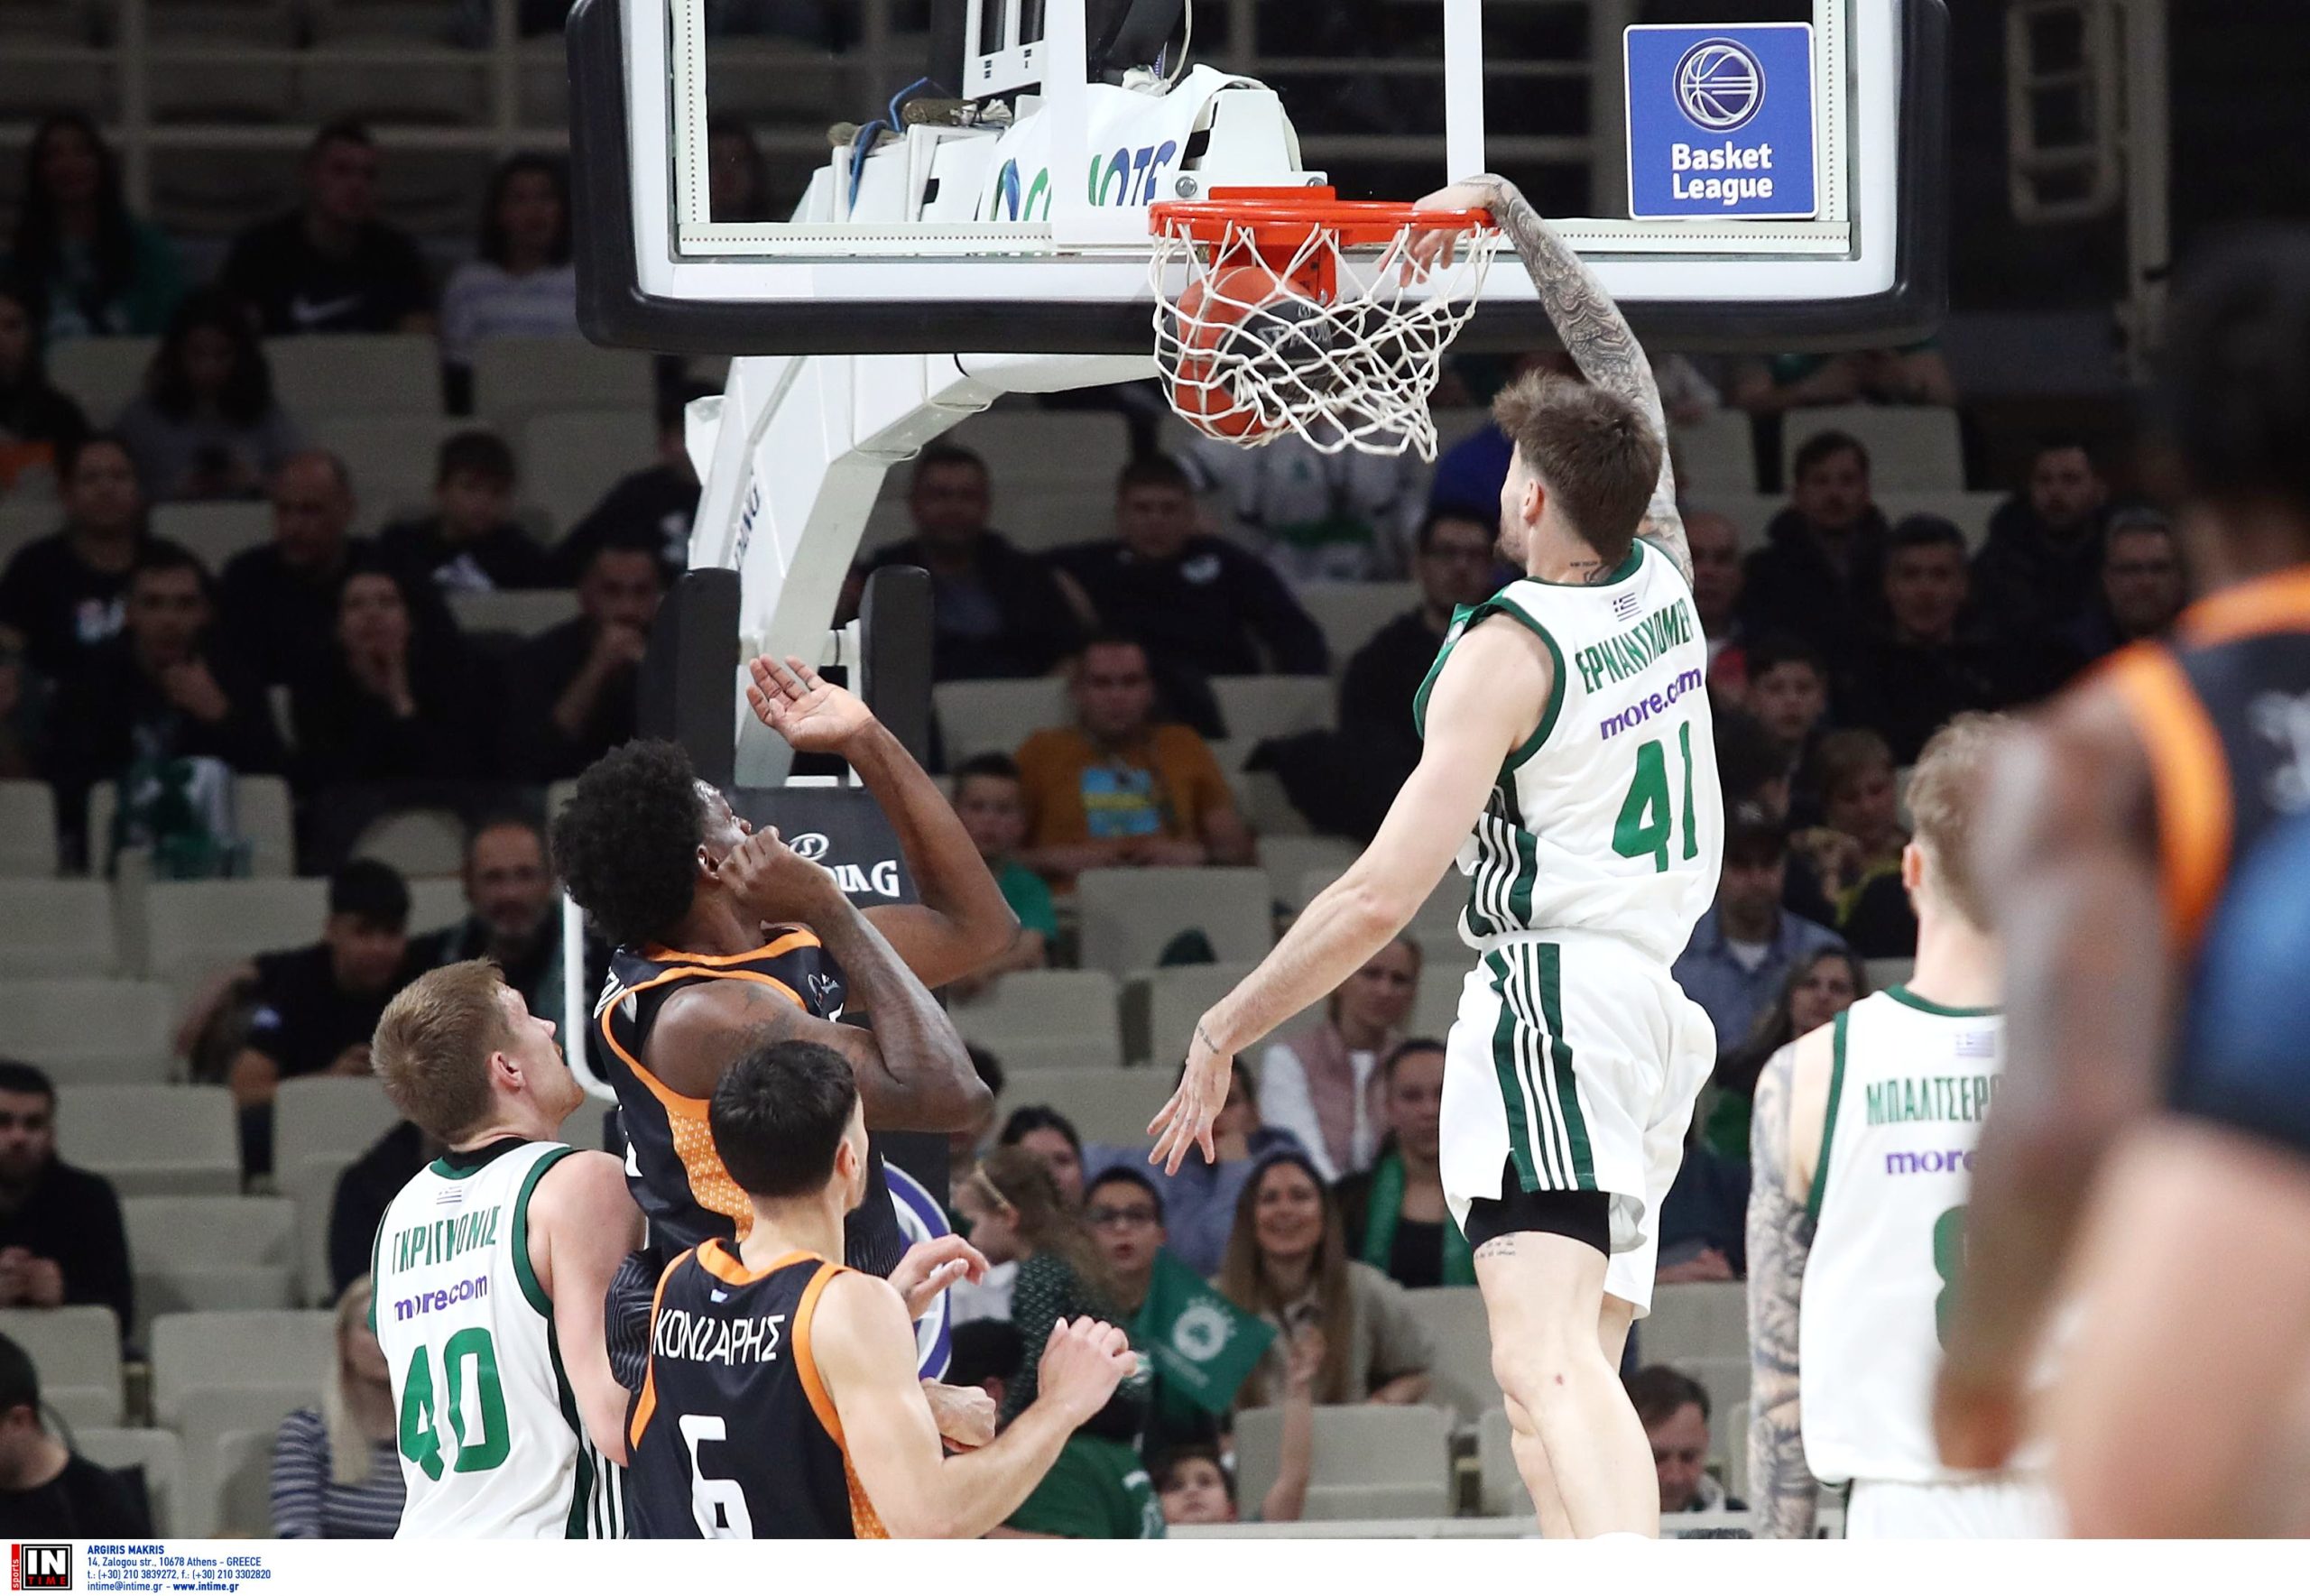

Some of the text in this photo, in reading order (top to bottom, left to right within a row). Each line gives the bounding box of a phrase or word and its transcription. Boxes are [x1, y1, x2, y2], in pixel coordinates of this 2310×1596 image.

[1671, 141, 1773, 171] Basket
[1672, 173, 1773, 207] League
[1601, 668, 1702, 740] more.cm
[1612, 720, 1698, 872] 41
[400, 1327, 511, 1481] 40
[679, 1414, 753, 1539] 6
